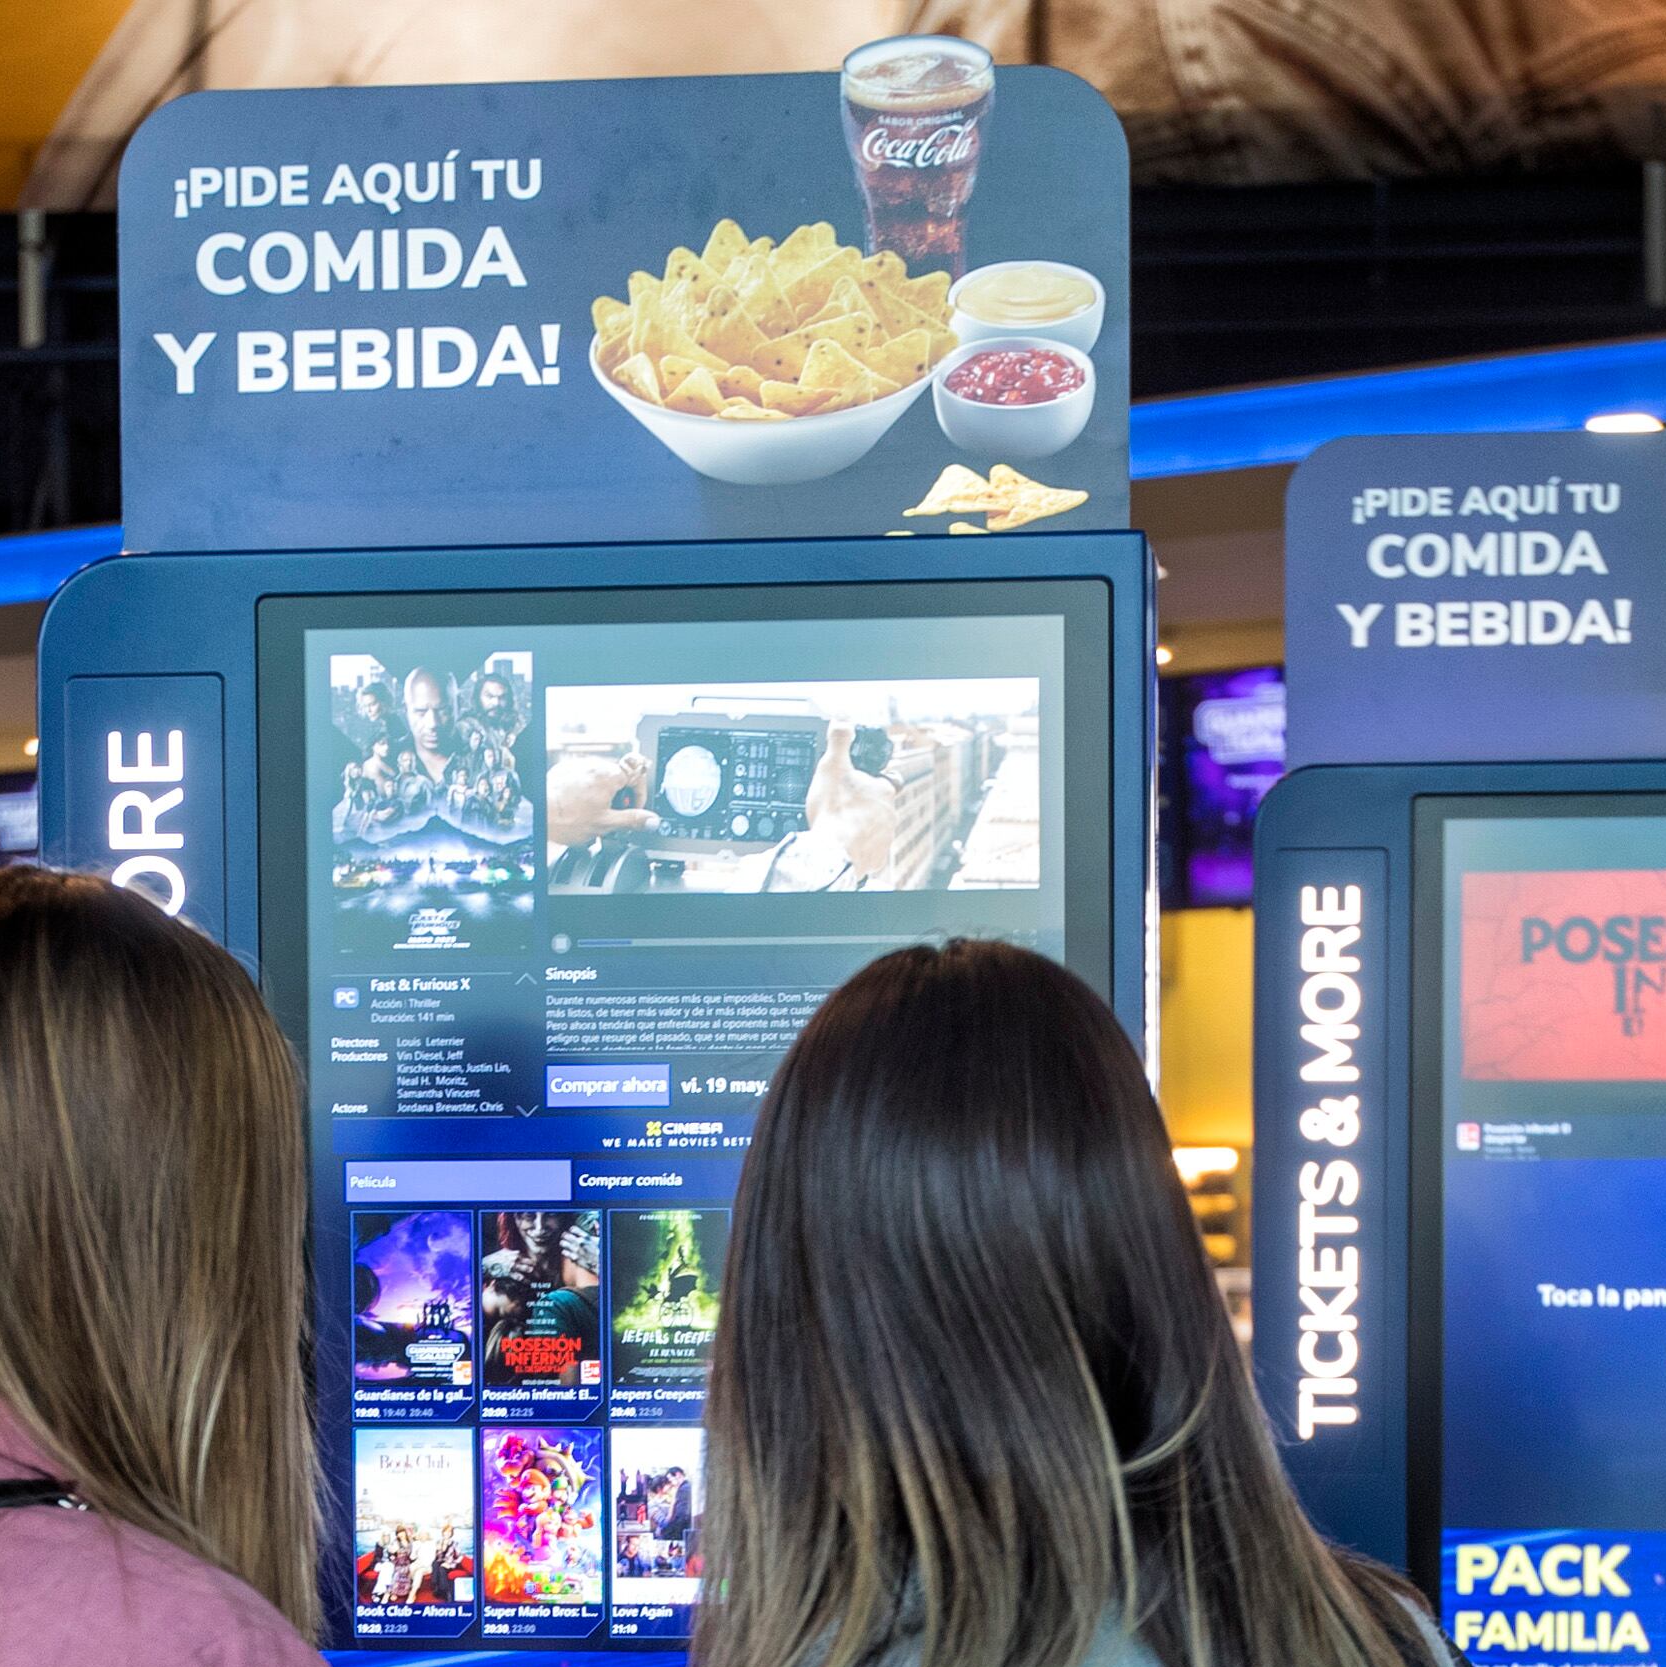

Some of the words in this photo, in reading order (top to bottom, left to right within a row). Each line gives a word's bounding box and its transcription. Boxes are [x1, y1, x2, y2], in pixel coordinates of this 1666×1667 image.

[174, 164, 309, 218] ¡PIDE
[321, 149, 461, 215] AQUÍ
[471, 158, 543, 201] TU
[196, 226, 528, 296] COMIDA
[153, 332, 217, 394] Y
[237, 324, 561, 393] BEBIDA!
[1352, 486, 1453, 524] ¡PIDE
[1458, 476, 1562, 522] AQUÍ
[1565, 482, 1621, 514] TU
[1366, 530, 1609, 579] COMIDA
[1335, 602, 1384, 648] Y
[1395, 599, 1632, 647] BEBIDA!
[107, 730, 186, 917] ORE
[546, 966, 597, 984] Sinopsis
[370, 979, 395, 992] Fast
[398, 979, 410, 991] &
[413, 978, 458, 991] Furious
[460, 978, 471, 991] X
[1299, 885, 1362, 1082] MORE
[336, 991, 356, 1004] PC
[370, 999, 403, 1009] Acción
[409, 998, 441, 1008] Thriller
[546, 994, 584, 1005] Durante
[585, 996, 637, 1005] numerosas
[638, 994, 680, 1004] misiones
[681, 993, 701, 1003] más
[703, 994, 721, 1005] que
[777, 992, 801, 1003] Dom
[371, 1012, 415, 1023] Duración:
[418, 1012, 434, 1022] 141
[436, 1012, 455, 1022] min
[546, 1008, 566, 1018] más
[596, 1008, 609, 1018] de
[610, 1008, 634, 1018] tener
[637, 1007, 657, 1017] más
[658, 1007, 682, 1017] valor
[684, 1008, 691, 1019] y
[692, 1006, 705, 1016] de
[715, 1006, 735, 1016] más
[737, 1005, 768, 1017] rápido
[769, 1007, 788, 1017] que
[546, 1020, 568, 1031] Pero
[569, 1020, 597, 1030] ahora
[598, 1020, 635, 1030] tendrán
[637, 1021, 656, 1031] que
[657, 1018, 710, 1030] enfrentarse
[712, 1018, 721, 1029] al
[723, 1020, 769, 1030] oponente
[770, 1018, 790, 1028] más
[332, 1037, 380, 1048] Directores
[396, 1037, 421, 1047] Louis
[546, 1033, 580, 1045] peligro
[581, 1034, 600, 1045] que
[602, 1034, 637, 1045] resurge
[639, 1032, 655, 1042] del
[694, 1033, 713, 1043] que
[715, 1032, 725, 1041] se
[727, 1032, 759, 1041] mueve
[761, 1032, 778, 1043] por
[332, 1051, 388, 1062] Productores
[396, 1051, 412, 1061] Vin
[446, 1050, 464, 1061] Jeff
[466, 1063, 493, 1073] Justin
[397, 1076, 419, 1086] Neal
[550, 1077, 619, 1096] Comprar
[622, 1076, 668, 1094] ahora
[680, 1077, 703, 1094] vi.
[706, 1077, 727, 1094] 19
[730, 1079, 769, 1097] may.
[397, 1089, 442, 1100] Samantha
[445, 1089, 480, 1099] Vincent
[332, 1103, 368, 1114] Actores
[396, 1103, 433, 1113] Jordana
[479, 1102, 504, 1112] Chris
[1299, 1094, 1361, 1147] &
[662, 1121, 723, 1135] CINESA
[602, 1138, 621, 1148] WE
[627, 1137, 663, 1147] MAKE
[668, 1137, 718, 1147] MOVIES
[350, 1176, 397, 1189] Película
[578, 1174, 634, 1190] Comprar
[636, 1173, 683, 1187] comida
[1298, 1159, 1361, 1441] TICKETS
[1537, 1284, 1593, 1307] Toca
[1597, 1283, 1620, 1307] la
[501, 1334, 581, 1352] POSESIÓN
[505, 1351, 579, 1367] INFERNAL
[354, 1389, 415, 1401] Guardianes
[417, 1389, 431, 1401] de
[433, 1389, 444, 1401] la
[482, 1389, 526, 1401] Posesión
[531, 1389, 577, 1401] infernal:
[610, 1389, 652, 1403] Jeepers
[1456, 1544, 1631, 1597] PACK
[357, 1606, 385, 1617] Book
[387, 1606, 413, 1617] Club
[422, 1606, 456, 1617] Ahora
[484, 1606, 515, 1620] Super
[518, 1606, 551, 1617] Mario
[613, 1606, 639, 1617] Love
[639, 1606, 673, 1620] Again
[1455, 1611, 1650, 1652] FAMILIA
